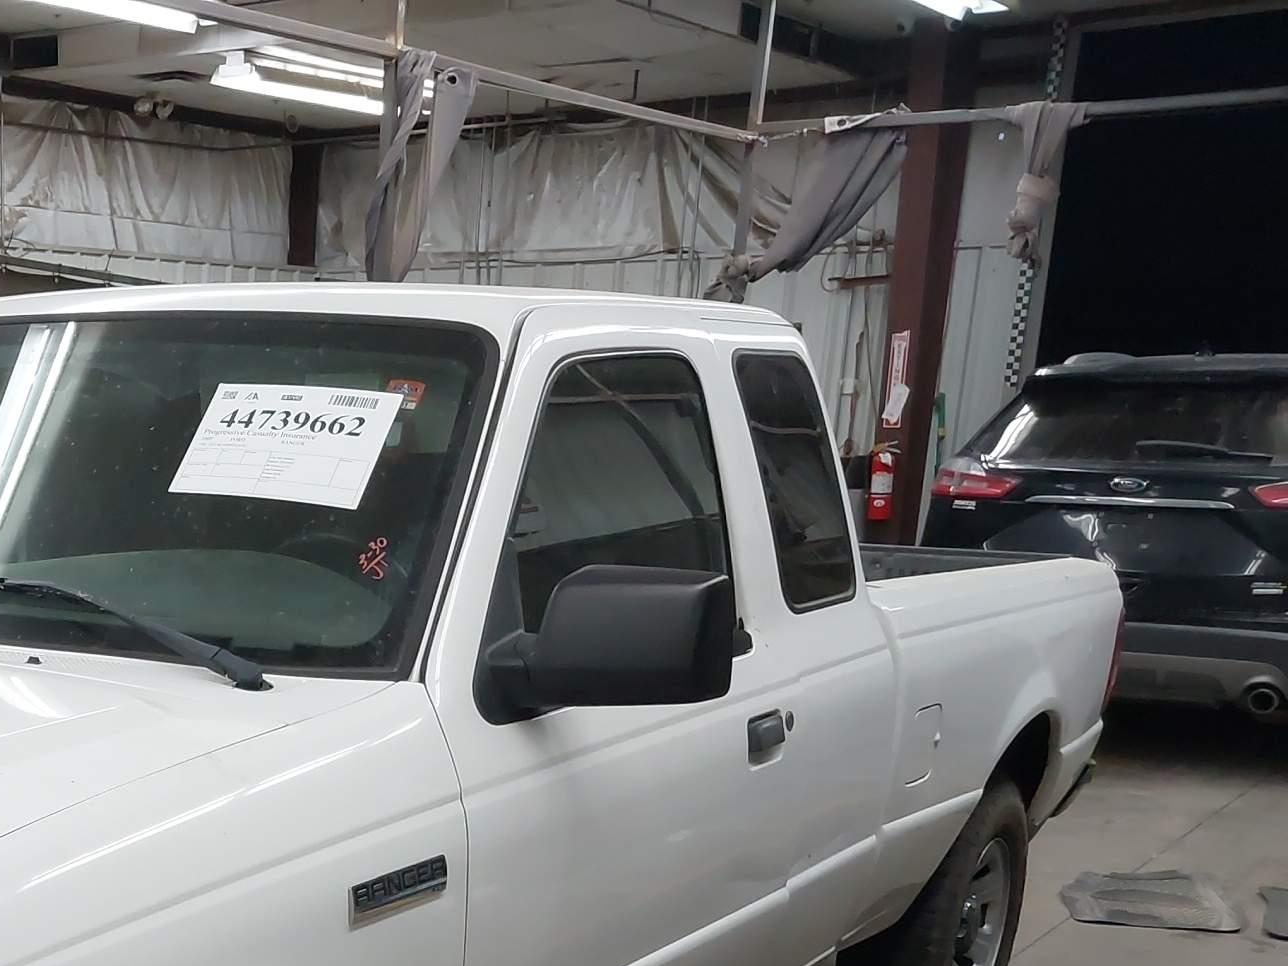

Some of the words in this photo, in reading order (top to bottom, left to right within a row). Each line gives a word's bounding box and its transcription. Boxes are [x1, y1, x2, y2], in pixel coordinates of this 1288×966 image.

[220, 409, 366, 437] 44739662
[281, 431, 317, 440] Insurance
[354, 861, 443, 906] RANGER
